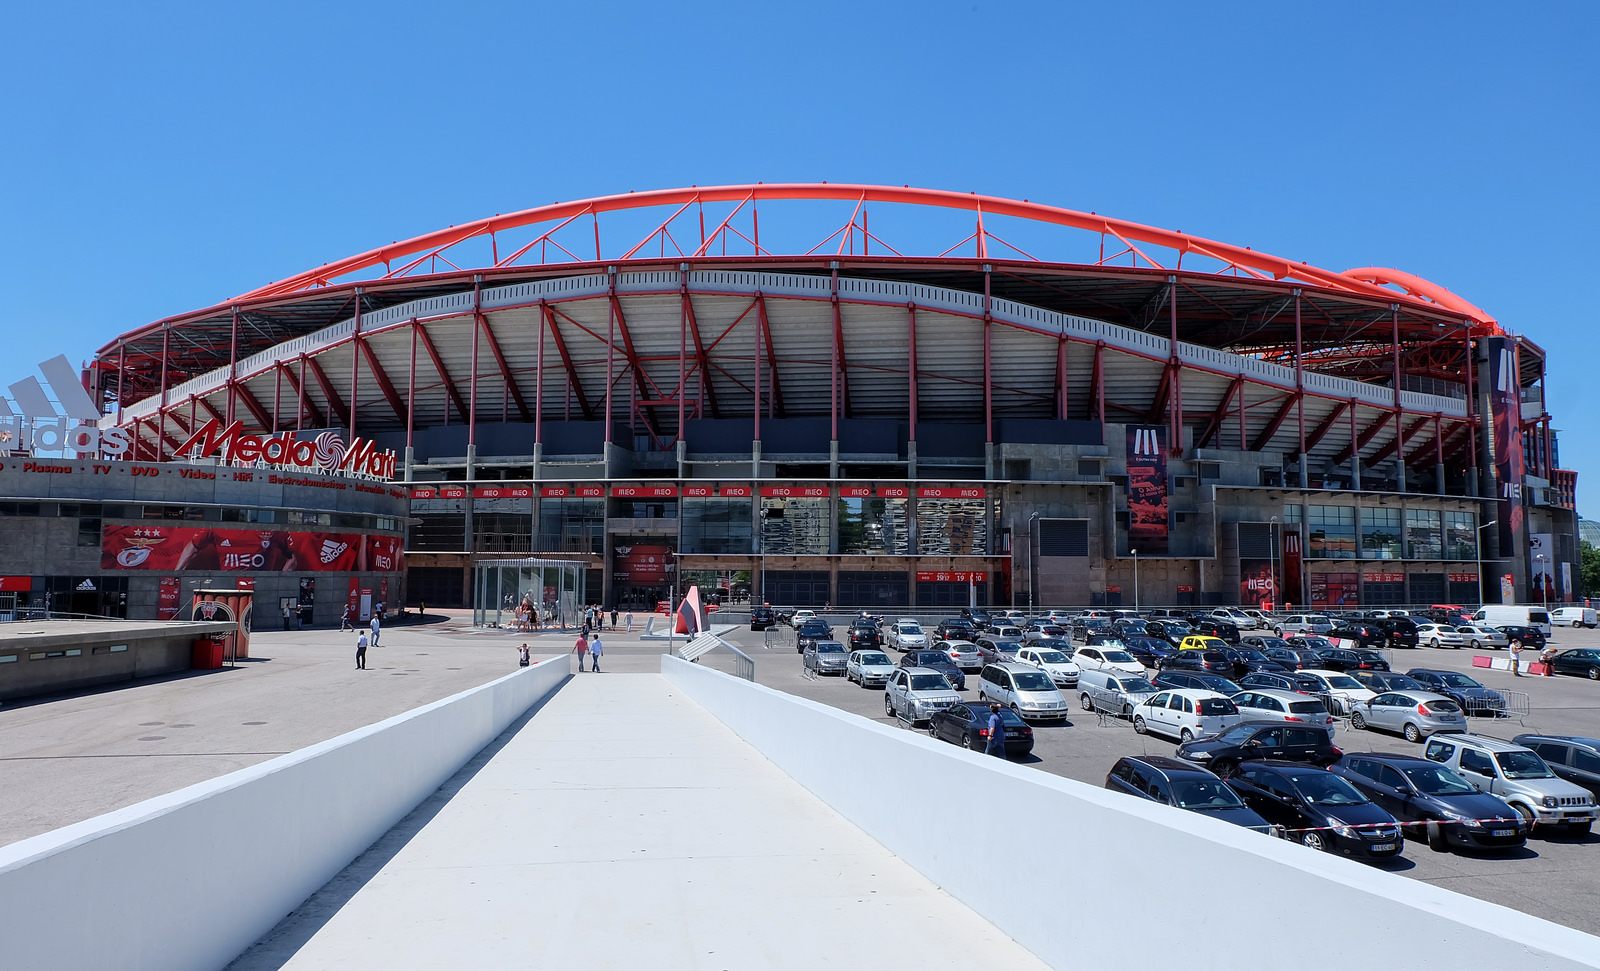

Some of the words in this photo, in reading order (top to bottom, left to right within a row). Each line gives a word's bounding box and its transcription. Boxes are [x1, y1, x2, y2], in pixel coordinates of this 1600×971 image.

[172, 418, 316, 466] Media
[23, 462, 72, 474] Plasma
[92, 464, 112, 475] TV
[131, 466, 159, 477] DVD
[179, 468, 216, 480] Video
[225, 553, 265, 568] MEO
[320, 542, 348, 564] adidas
[376, 554, 392, 570] MEO
[1248, 579, 1273, 590] MEO
